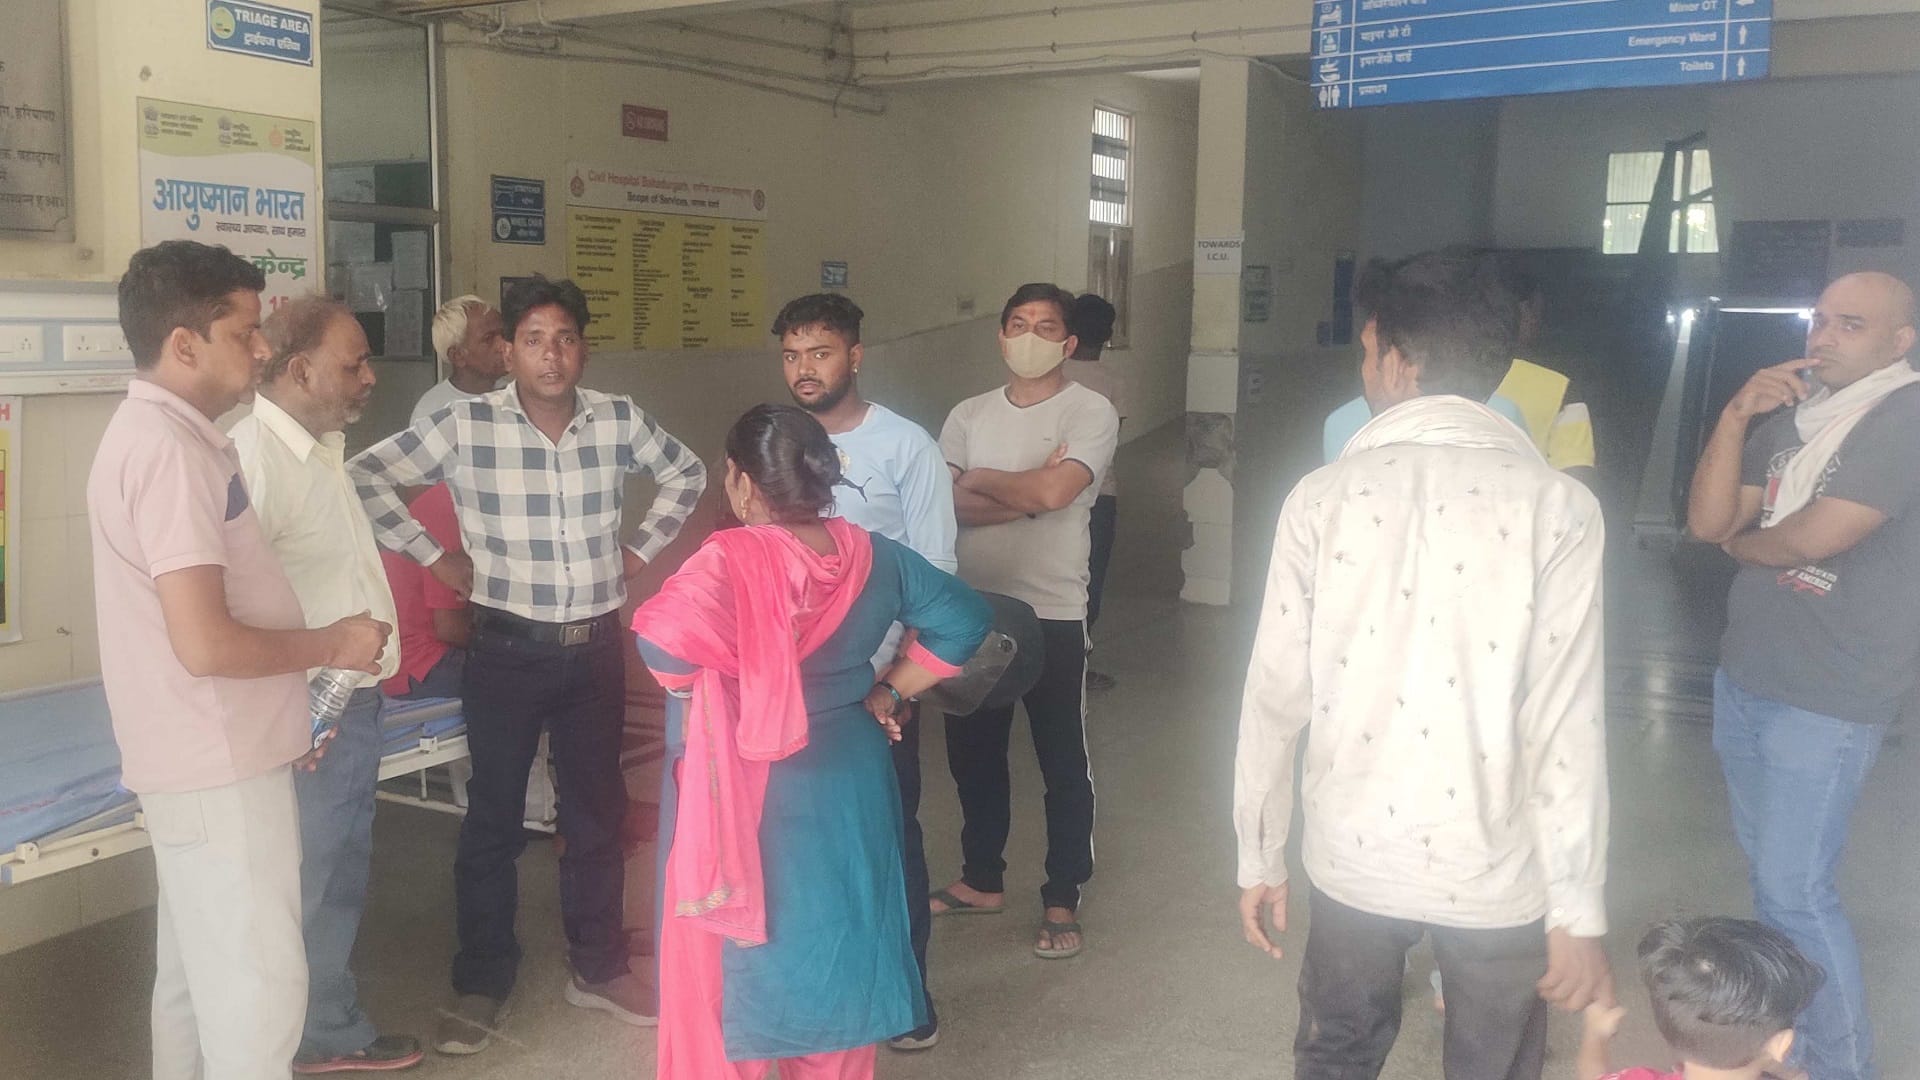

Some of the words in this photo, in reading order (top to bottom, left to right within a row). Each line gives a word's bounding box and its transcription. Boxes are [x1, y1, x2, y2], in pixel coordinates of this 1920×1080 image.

[1669, 3, 1700, 13] Minor
[1702, 1, 1718, 10] OT
[234, 9, 278, 28] TRIAGE
[280, 18, 310, 35] AREA
[1688, 32, 1717, 43] Ward
[1679, 61, 1714, 72] Toilets
[588, 169, 607, 182] Civil
[608, 173, 640, 186] Hospital
[627, 191, 649, 204] Scope
[650, 193, 659, 204] of
[153, 178, 249, 231] आयुष्मान
[256, 188, 305, 221] भारत
[1198, 241, 1241, 249] TOWARDS
[1207, 253, 1230, 261] I.C.U.
[250, 248, 308, 280] केन्द्र
